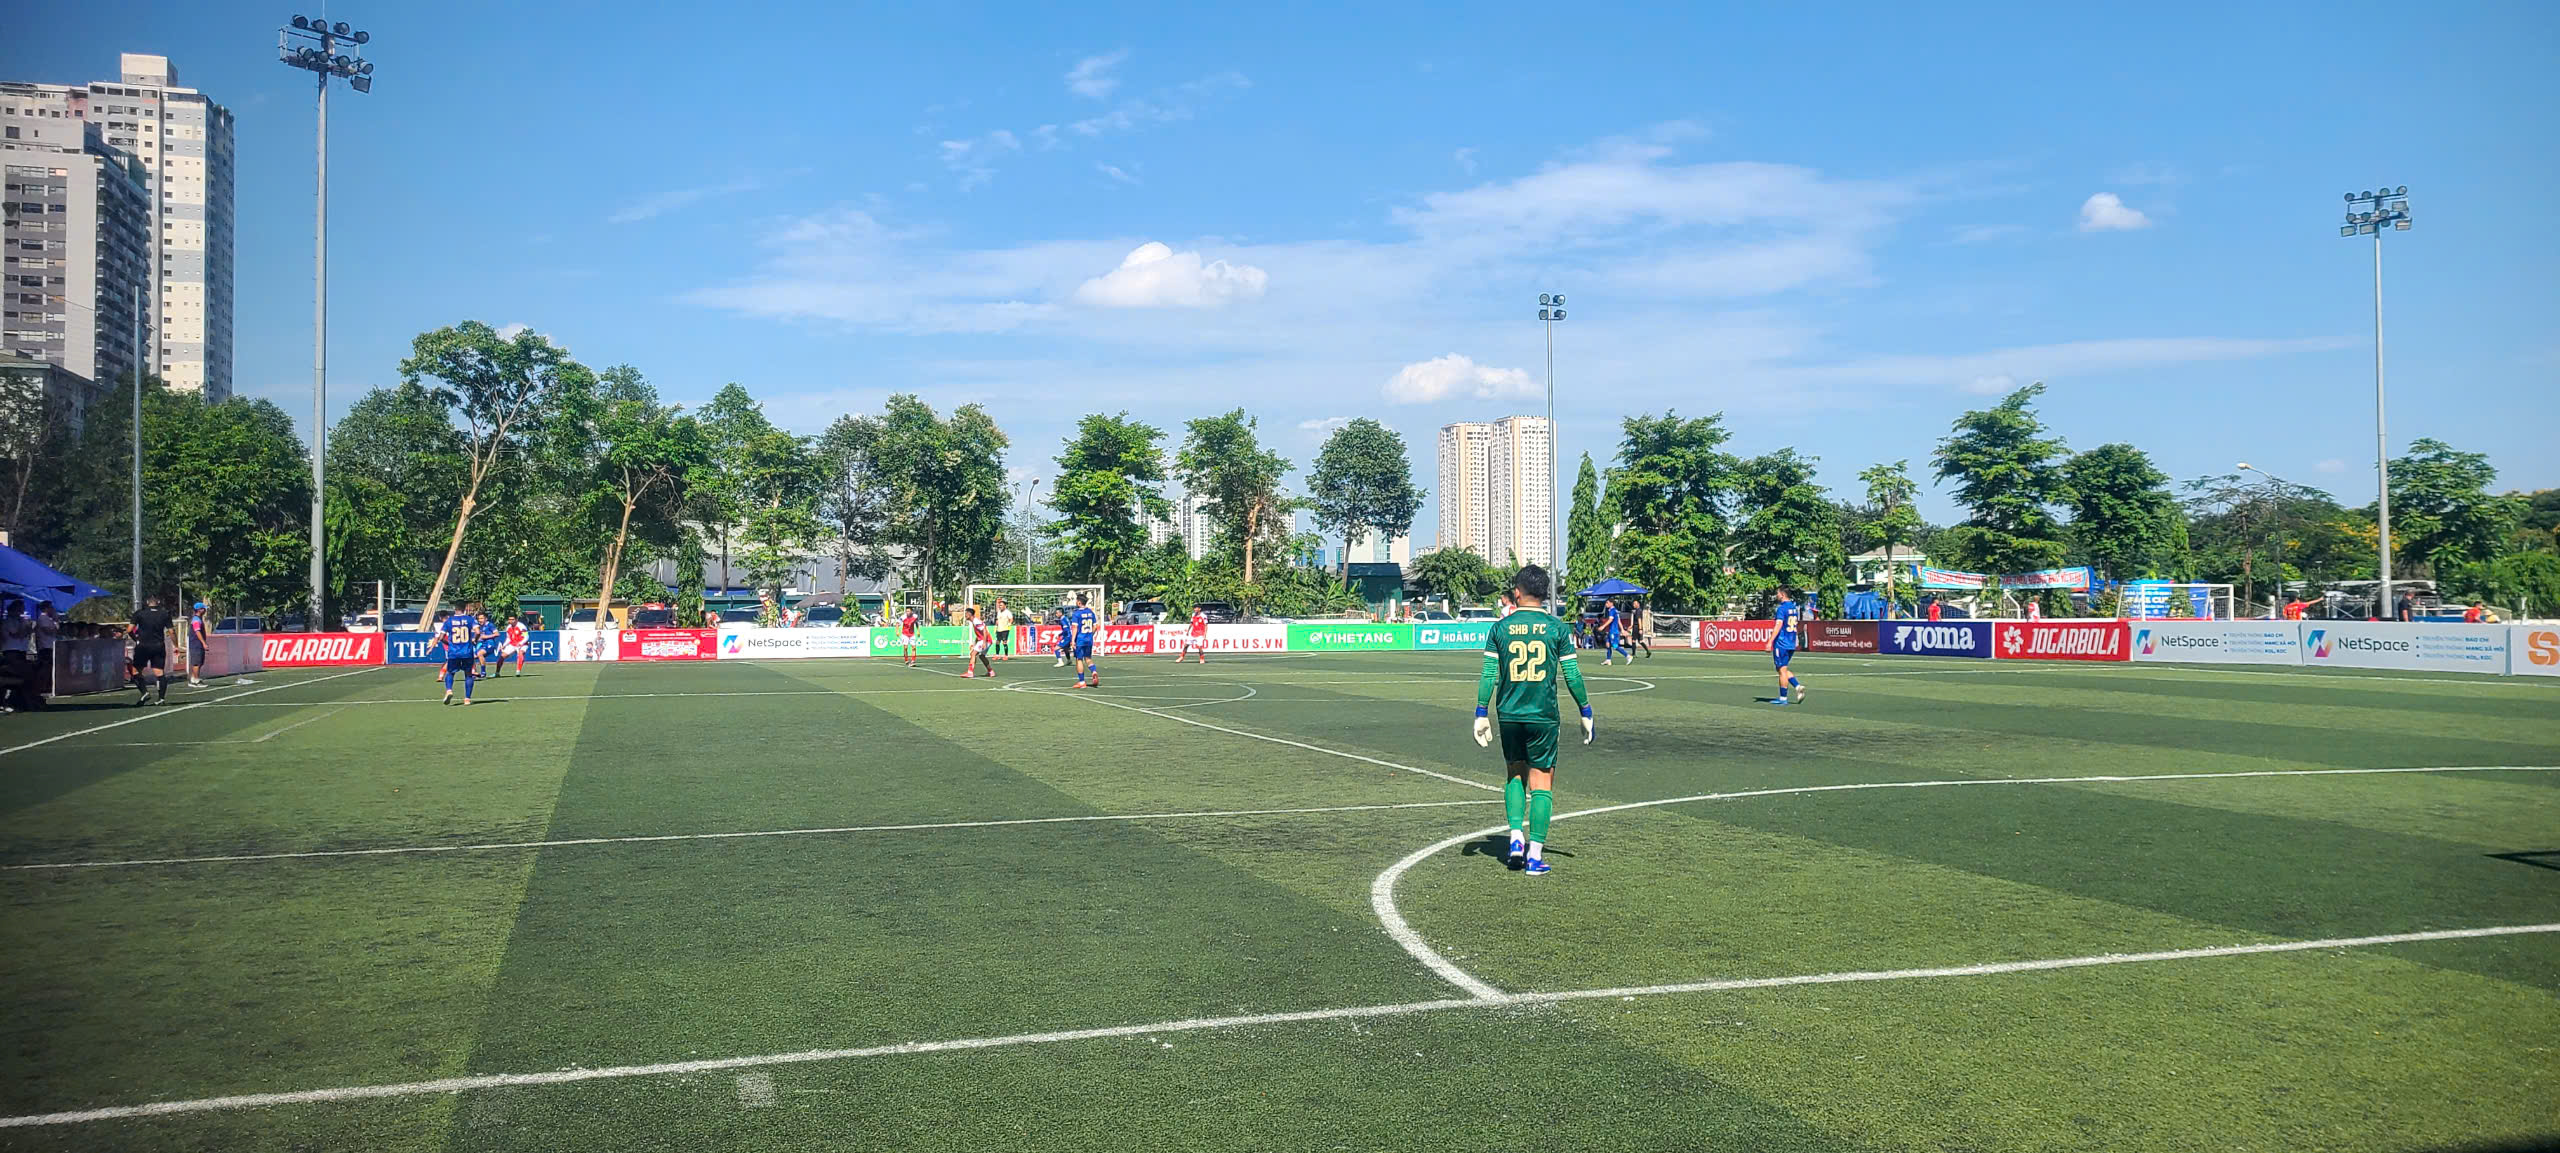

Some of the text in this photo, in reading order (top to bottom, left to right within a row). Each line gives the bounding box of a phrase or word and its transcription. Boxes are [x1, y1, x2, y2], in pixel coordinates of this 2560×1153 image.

[452, 626, 469, 644] 20
[1038, 629, 1150, 644] STBALM
[1508, 623, 1547, 635] SHB FC
[1718, 628, 1738, 643] PSD
[748, 638, 803, 649] NetSpace
[1323, 632, 1394, 643] YIHETANG
[1478, 632, 1488, 642] H
[2027, 628, 2120, 655] JOGARBOLA
[2161, 635, 2219, 649] NetSpace
[262, 638, 371, 662] OGARBOLA
[1119, 644, 1146, 653] CARE
[2338, 637, 2410, 653] NetSpace
[1508, 640, 1547, 682] 22
